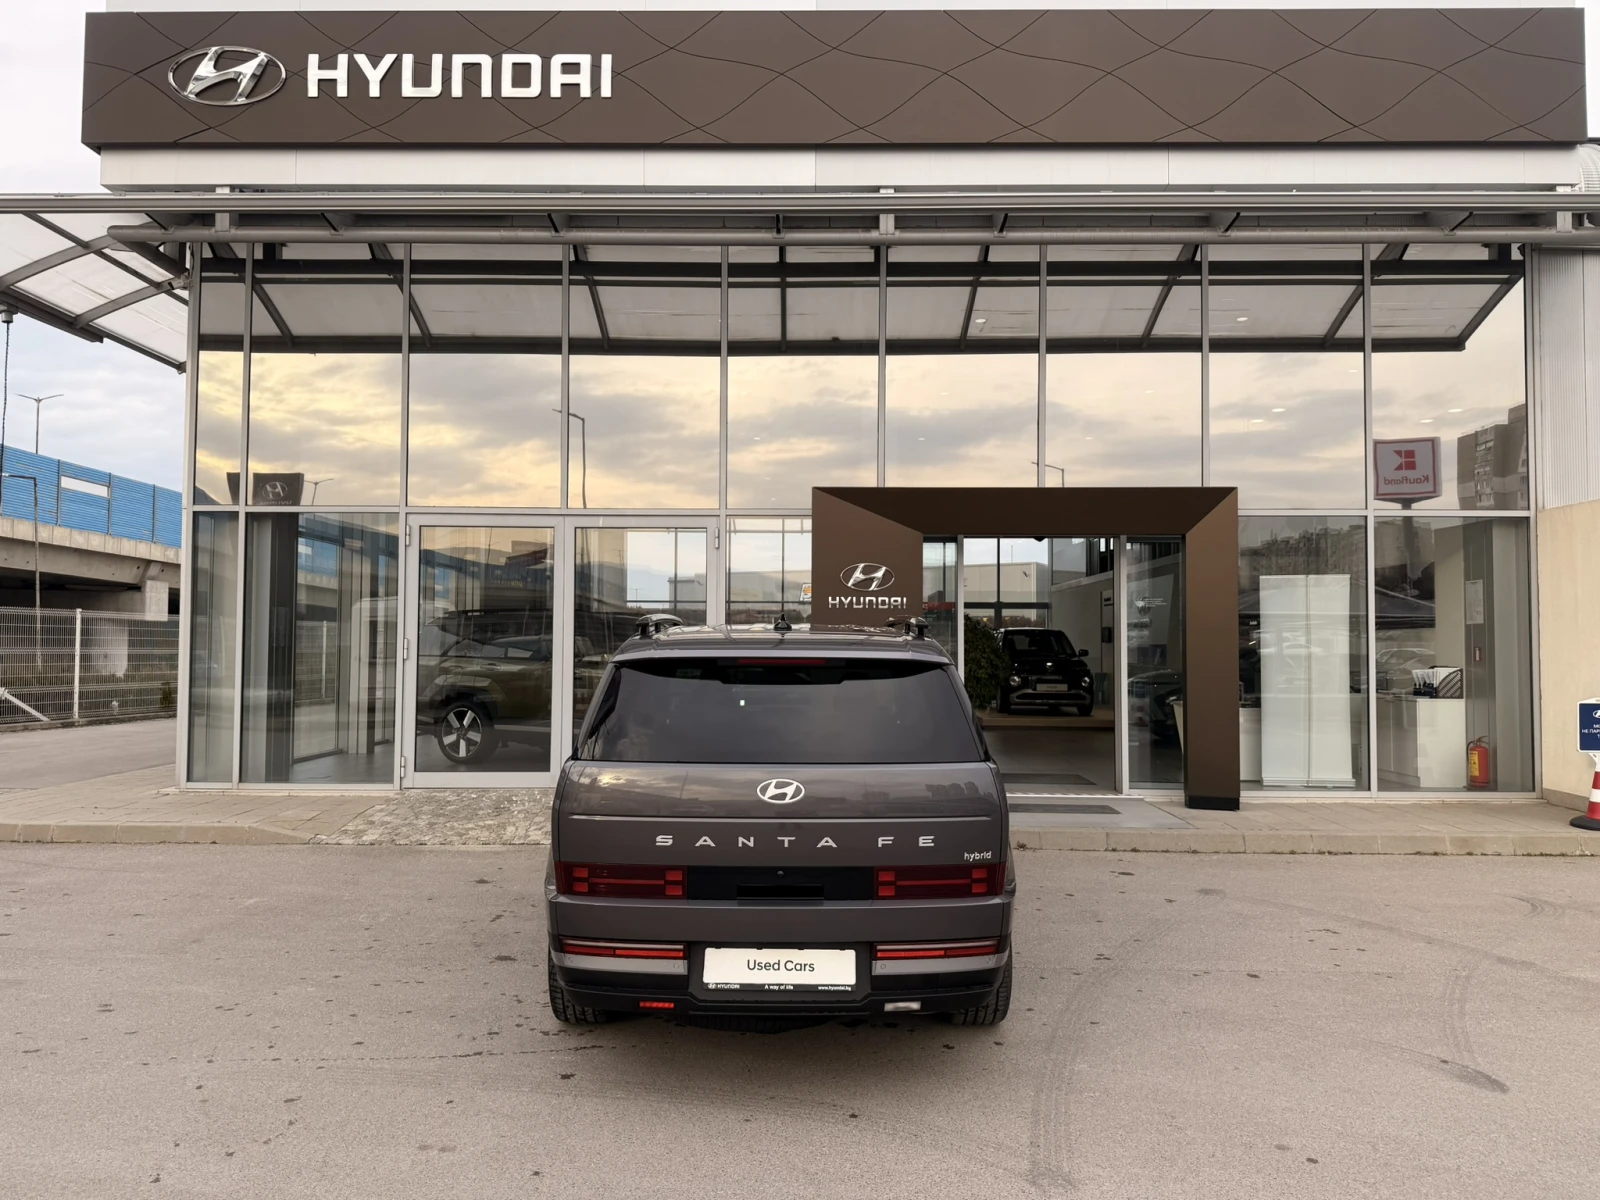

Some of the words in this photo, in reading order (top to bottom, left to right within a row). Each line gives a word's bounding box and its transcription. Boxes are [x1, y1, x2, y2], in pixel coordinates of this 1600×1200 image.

[307, 53, 612, 98] HYUNDAI
[828, 596, 907, 609] HYUNDAI
[655, 835, 838, 848] SANTA
[877, 836, 935, 848] FE
[964, 850, 992, 862] hybrid
[747, 959, 781, 971] Used
[784, 960, 815, 972] Cars
